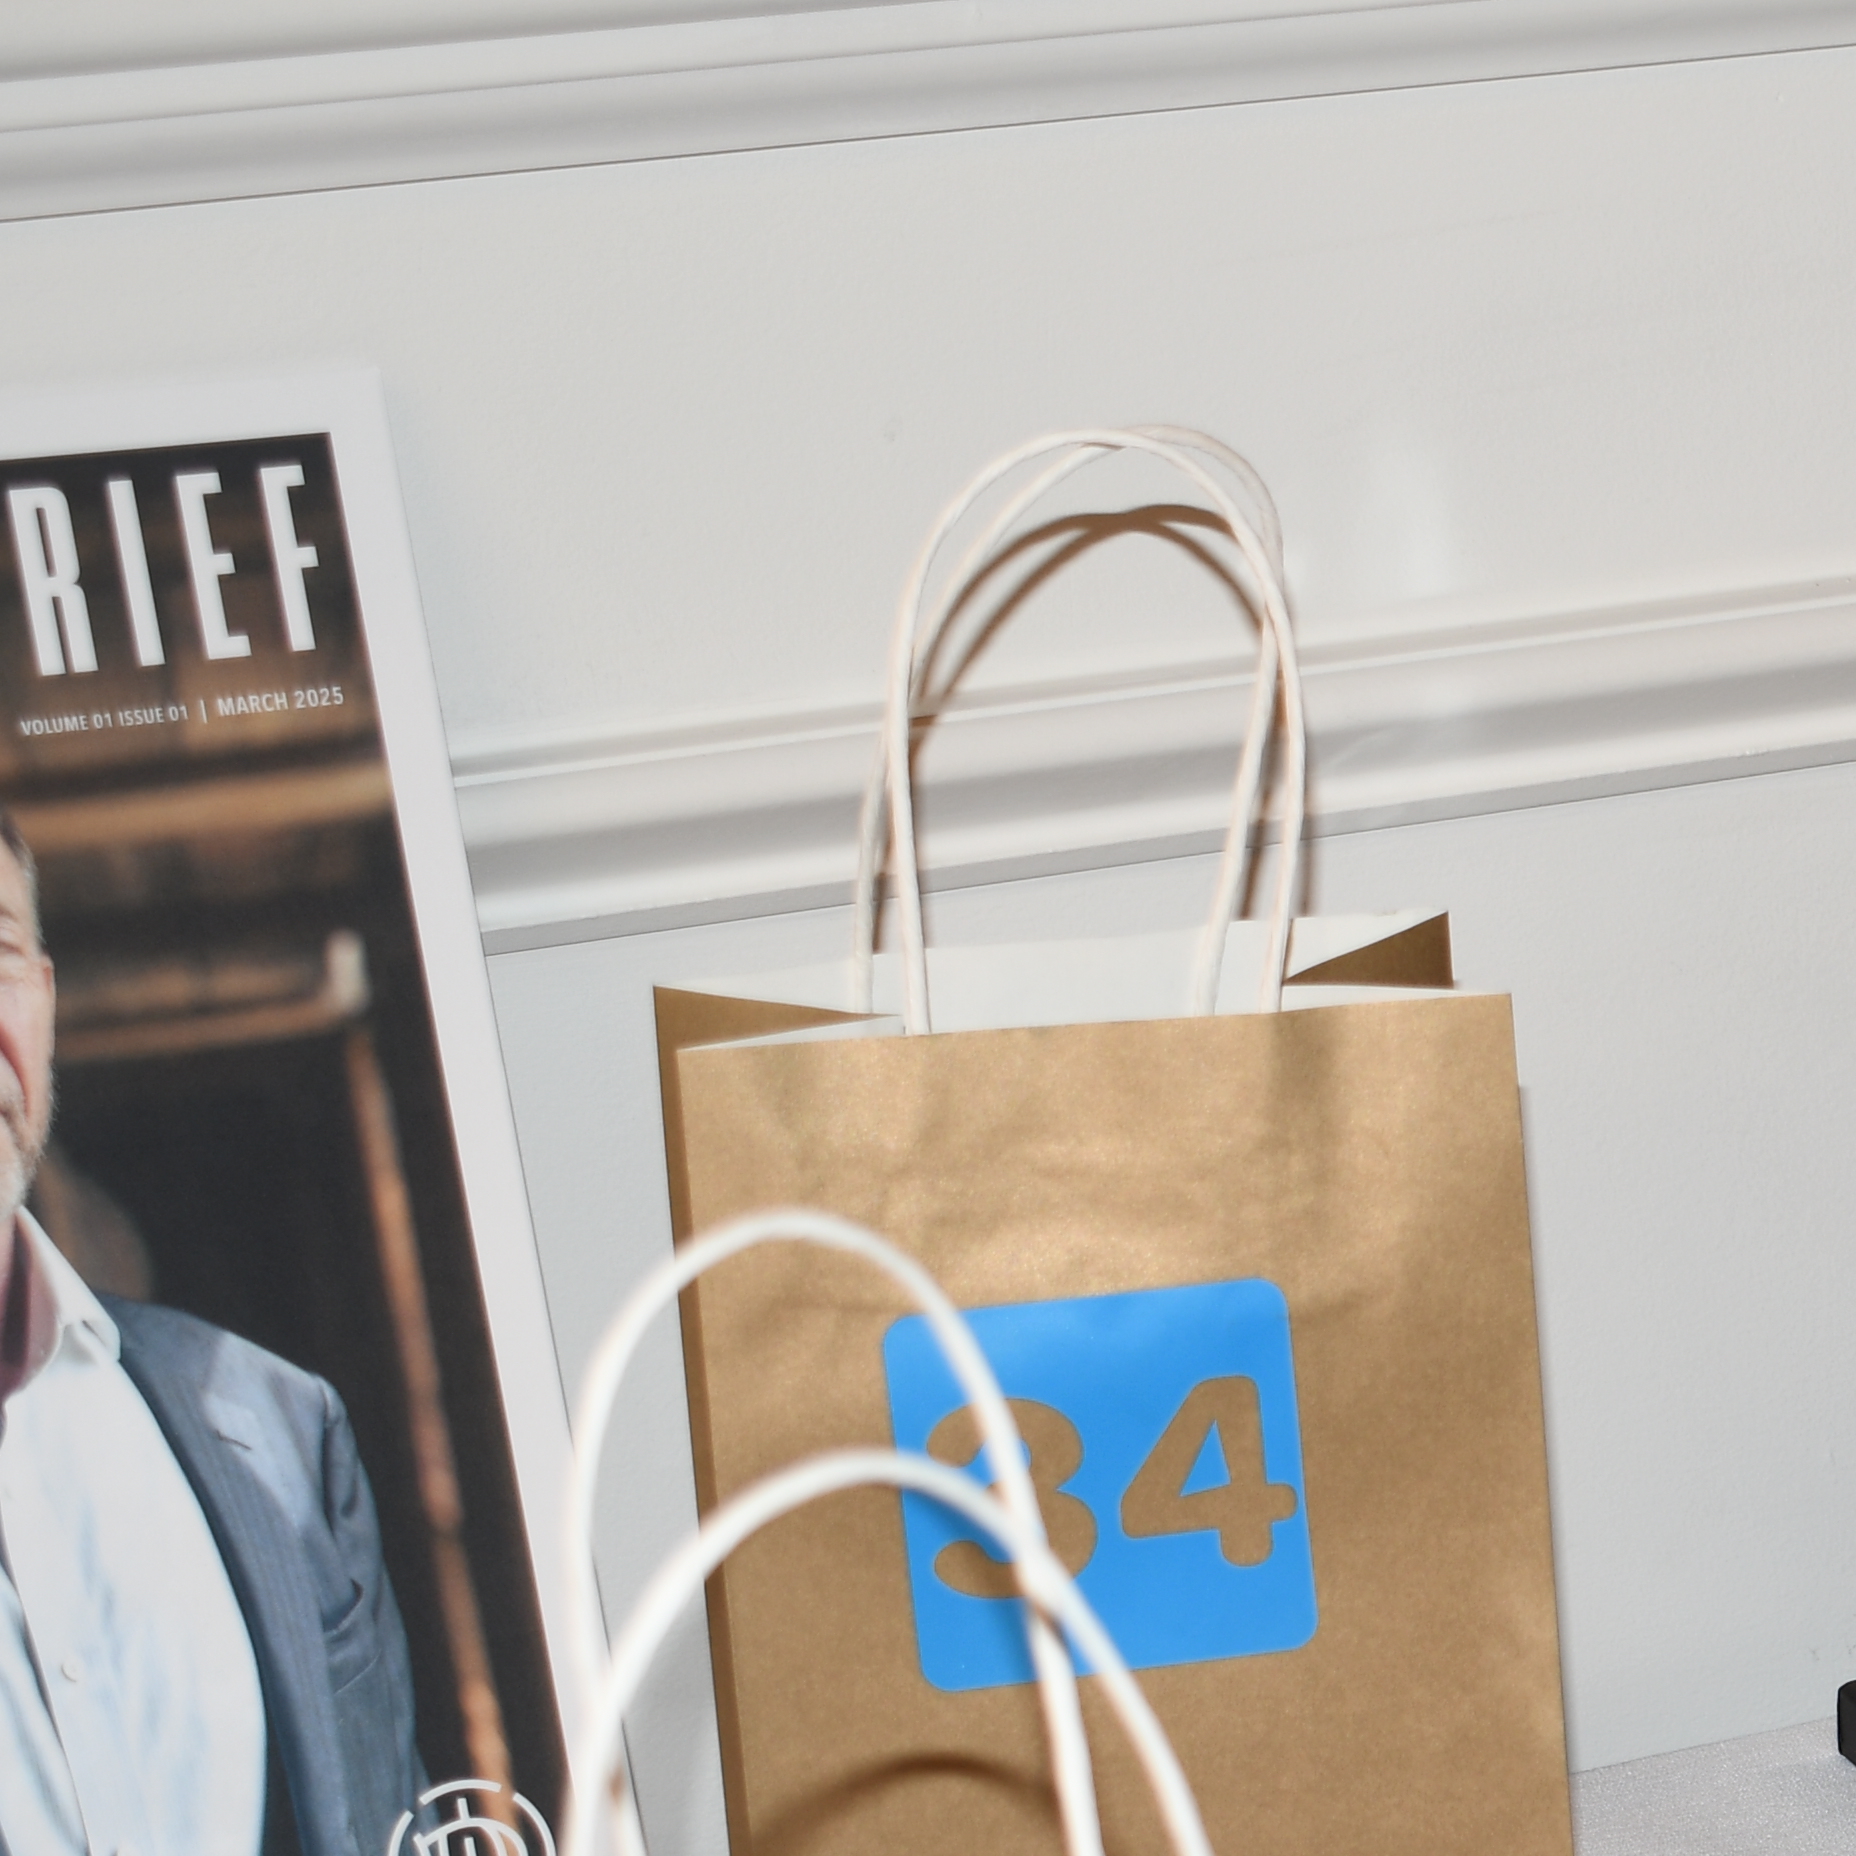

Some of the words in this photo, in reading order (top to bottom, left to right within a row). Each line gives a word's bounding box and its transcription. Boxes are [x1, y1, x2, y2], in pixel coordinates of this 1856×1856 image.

[20, 715, 90, 737] VOLUME
[93, 712, 115, 729] 01
[119, 706, 165, 728] ISSUE
[168, 705, 190, 722] 01
[217, 690, 290, 718] MARCH
[294, 686, 345, 710] 2025
[925, 1374, 1298, 1600] 34
